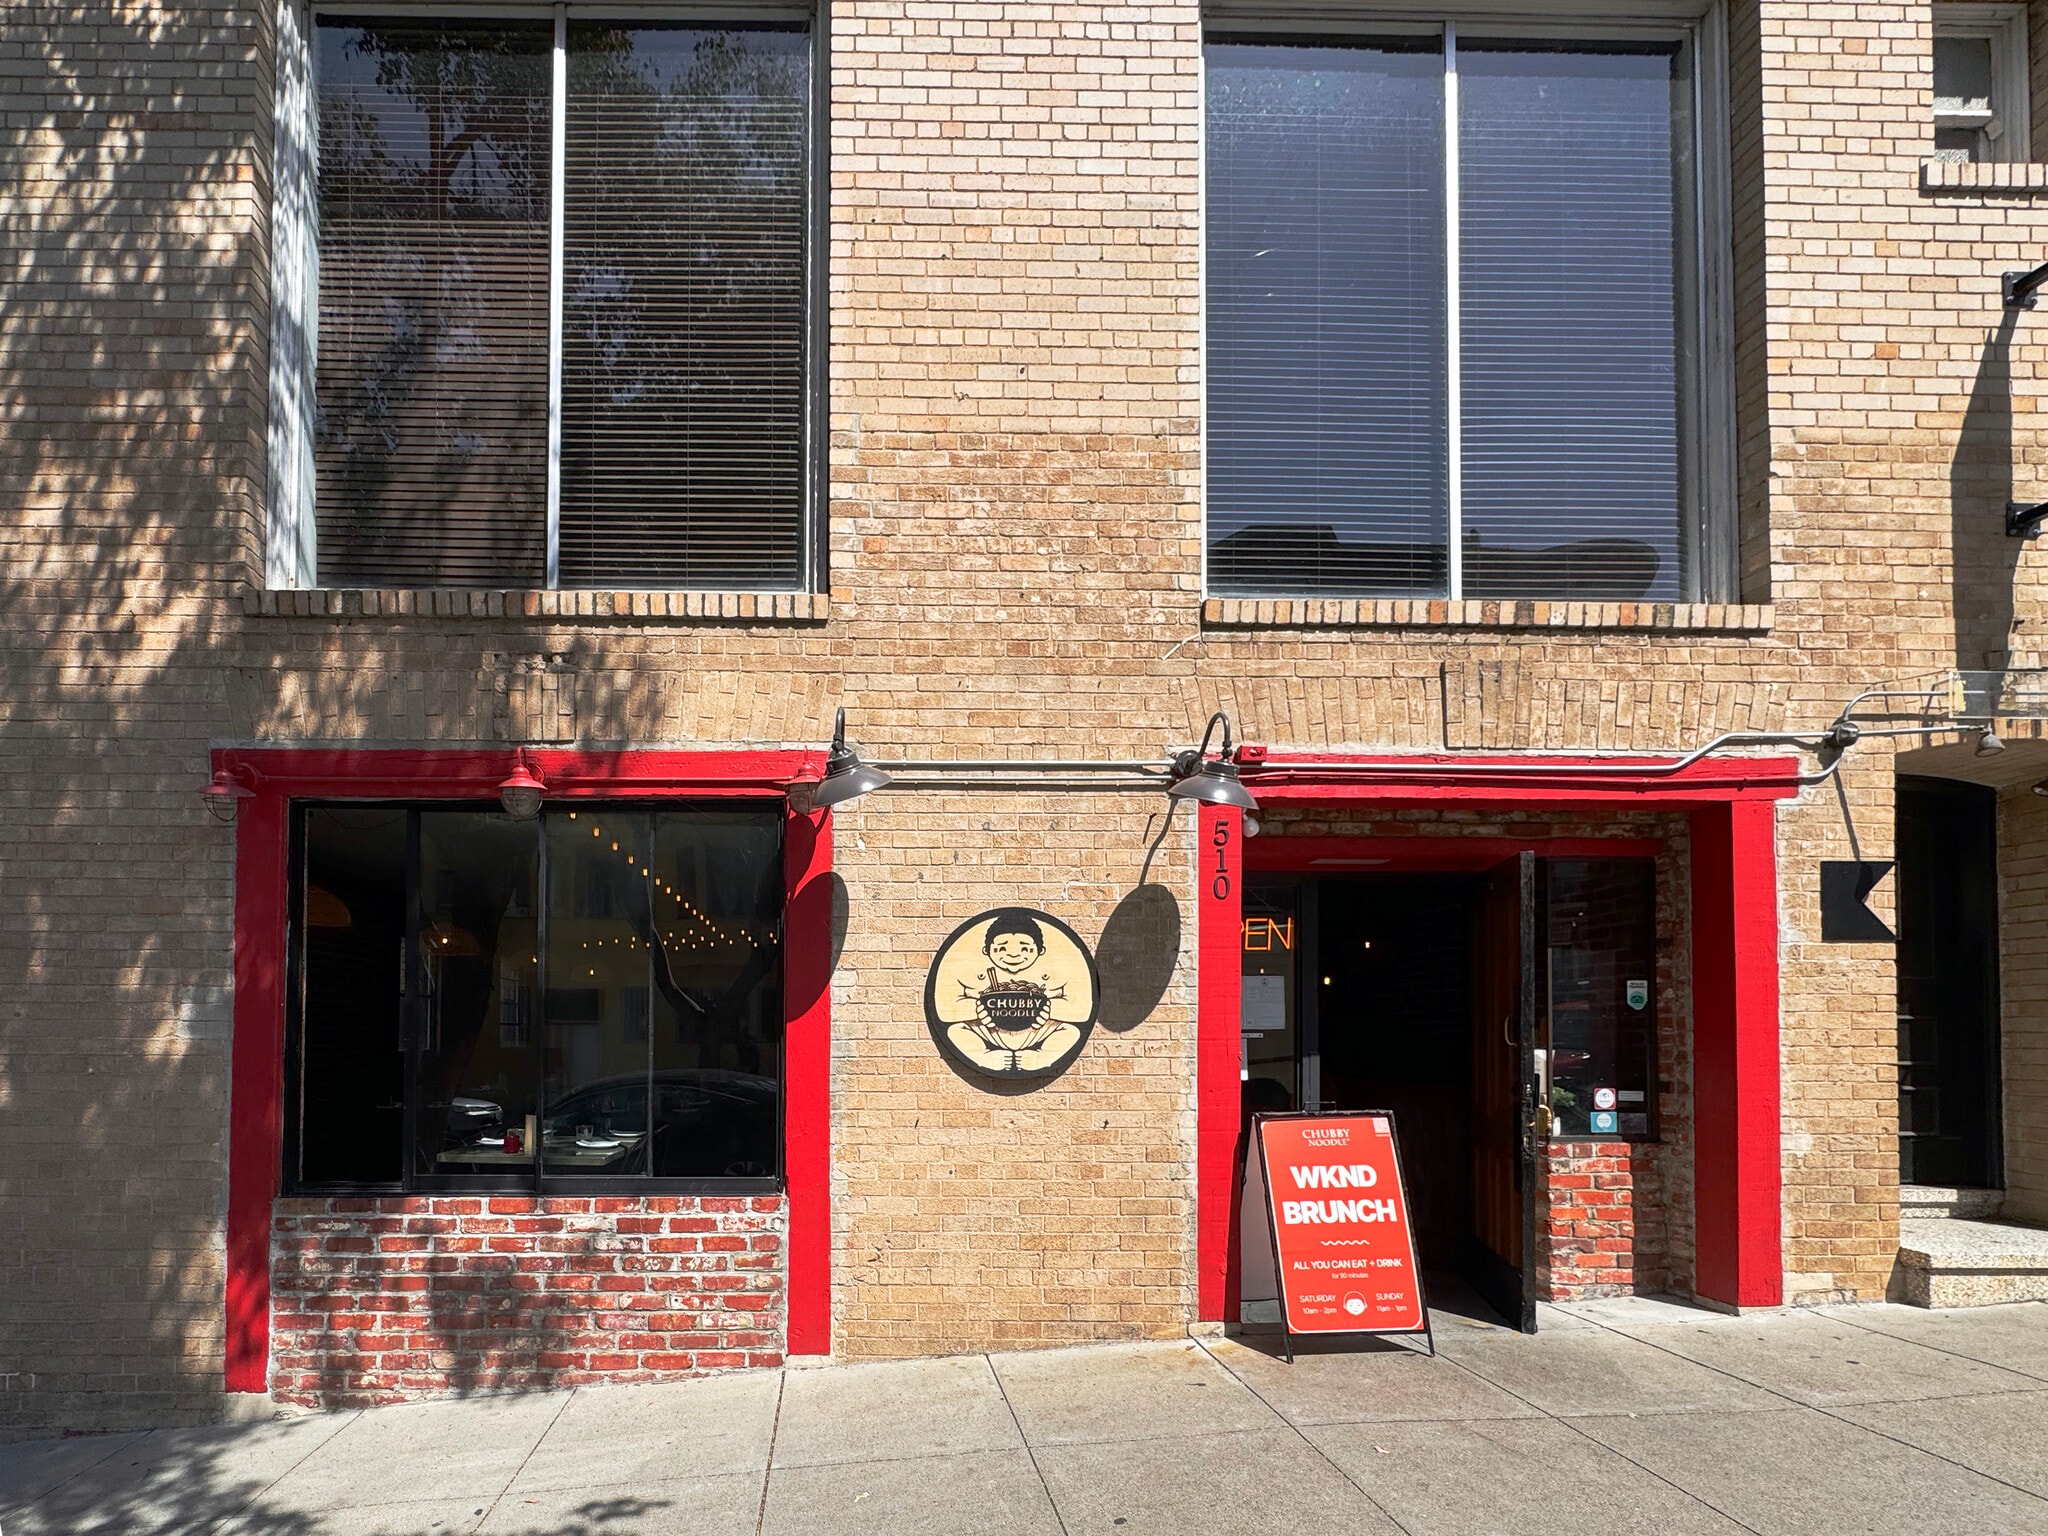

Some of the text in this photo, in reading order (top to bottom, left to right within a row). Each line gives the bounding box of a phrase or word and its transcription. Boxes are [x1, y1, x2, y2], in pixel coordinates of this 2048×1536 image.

[1213, 820, 1230, 900] 510
[1240, 917, 1291, 951] EN
[986, 998, 1042, 1008] CHUBBY
[991, 1009, 1037, 1017] NOODLE
[1302, 1128, 1350, 1139] CHUBBY
[1308, 1138, 1349, 1147] NOODLE
[1289, 1164, 1377, 1189] WKND
[1282, 1198, 1398, 1225] BRUNCH
[1293, 1261, 1310, 1270] ALL
[1310, 1260, 1330, 1270] YOU
[1331, 1260, 1351, 1269] CAN
[1351, 1259, 1368, 1269] EAT
[1376, 1258, 1403, 1268] DRINK
[1299, 1294, 1337, 1303] SATURDAY
[1375, 1292, 1404, 1301] SUNDAY
